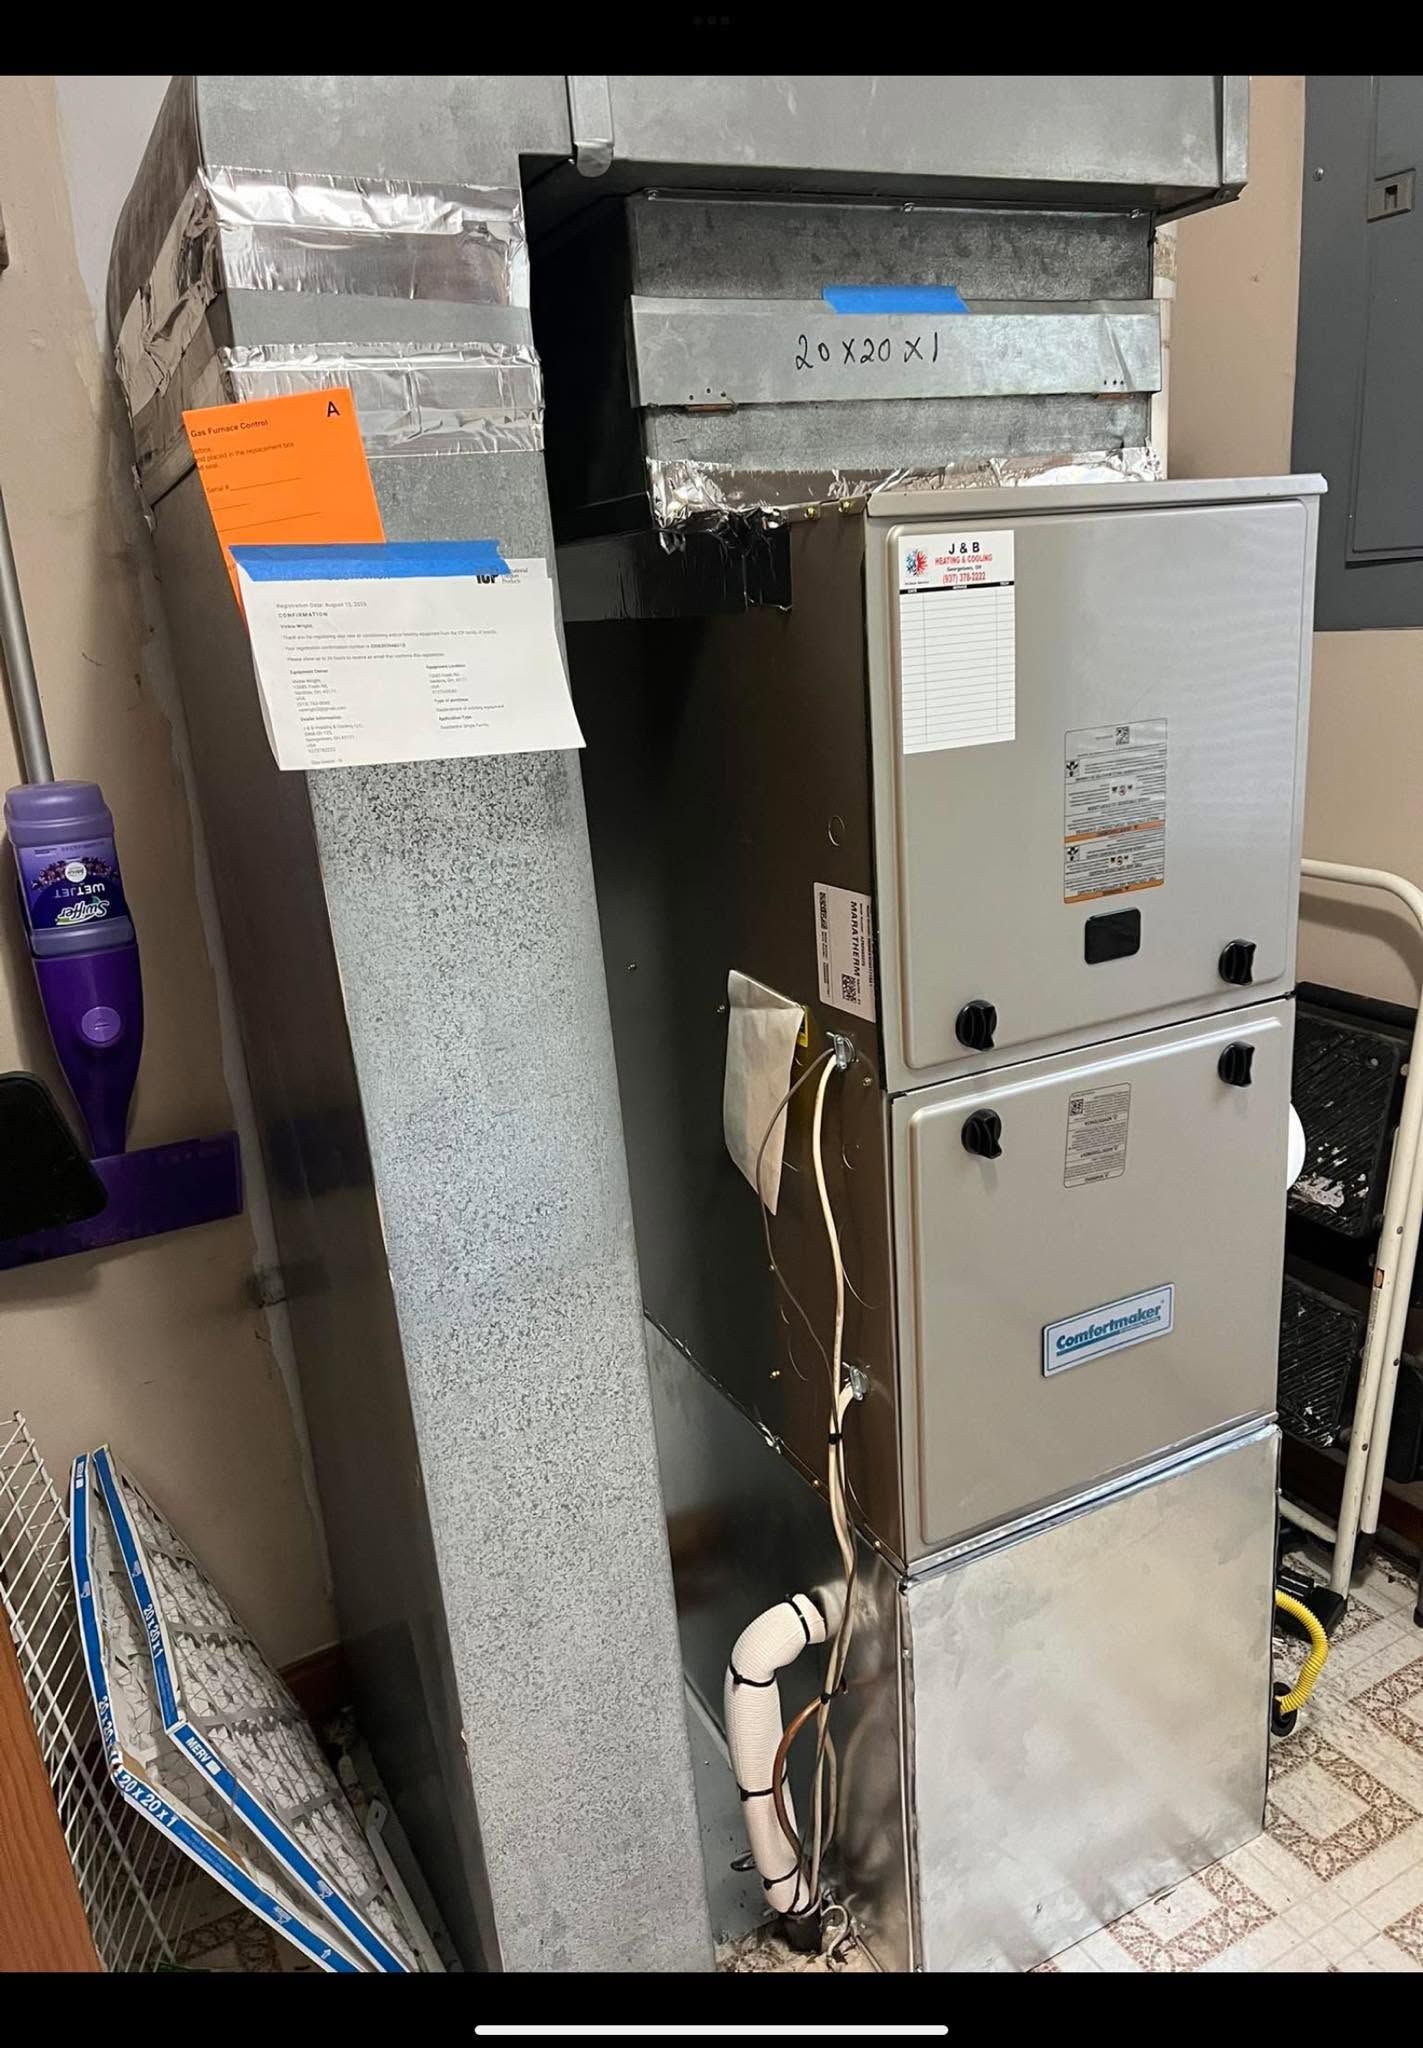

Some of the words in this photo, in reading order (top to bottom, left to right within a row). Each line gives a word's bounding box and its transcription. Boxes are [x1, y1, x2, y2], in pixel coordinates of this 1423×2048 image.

[326, 401, 341, 418] A
[190, 428, 206, 438] Gas
[208, 424, 239, 435] Furnace
[240, 419, 269, 430] Control
[949, 543, 955, 555] J
[960, 542, 968, 554] &
[972, 541, 980, 553] B
[935, 555, 960, 566] HEATING
[968, 553, 993, 564] COOLING
[943, 571, 958, 585] (937)
[960, 571, 986, 583] 378-2222
[278, 610, 328, 619] CONFIRMATION
[54, 882, 106, 899] WETJET
[57, 900, 110, 922] Swiffer
[850, 901, 861, 977] MARATHERM
[1056, 1304, 1161, 1350] Comfortmaker
[185, 1737, 212, 1763] MERV
